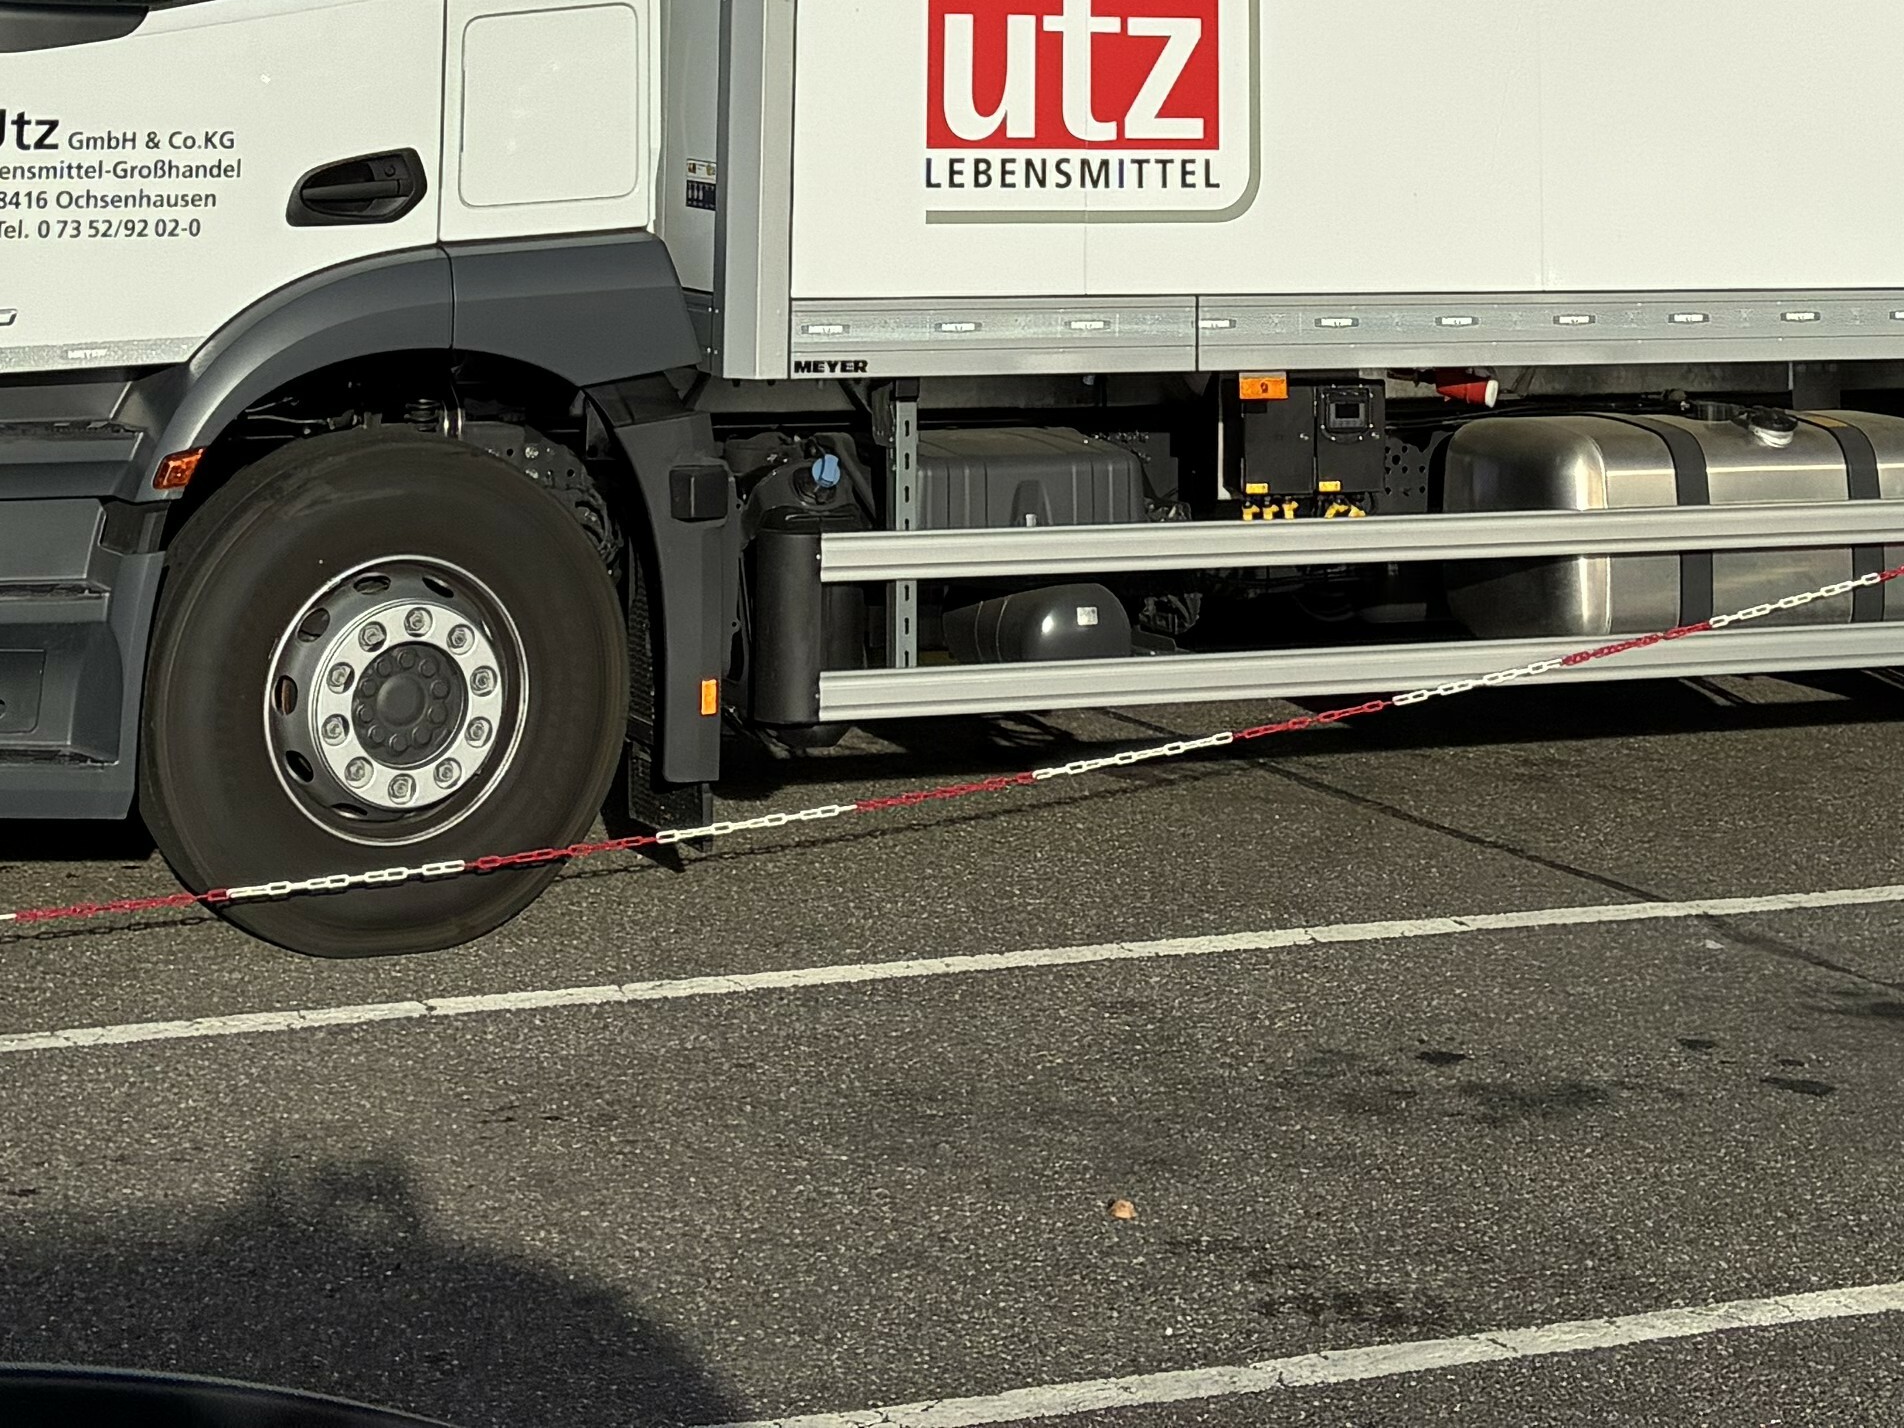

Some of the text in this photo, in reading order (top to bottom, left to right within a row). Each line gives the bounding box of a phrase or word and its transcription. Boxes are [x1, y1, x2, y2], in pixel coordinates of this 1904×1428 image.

[67, 130, 137, 151] GmbH
[145, 130, 161, 150] &
[925, 157, 1221, 189] LEBENSMITTEL
[55, 188, 217, 210] Ochsenhausen
[37, 219, 51, 239] 0
[56, 219, 82, 239] 73
[87, 218, 149, 240] 52/92
[154, 218, 201, 238] 02-0
[793, 359, 869, 374] MEYER
